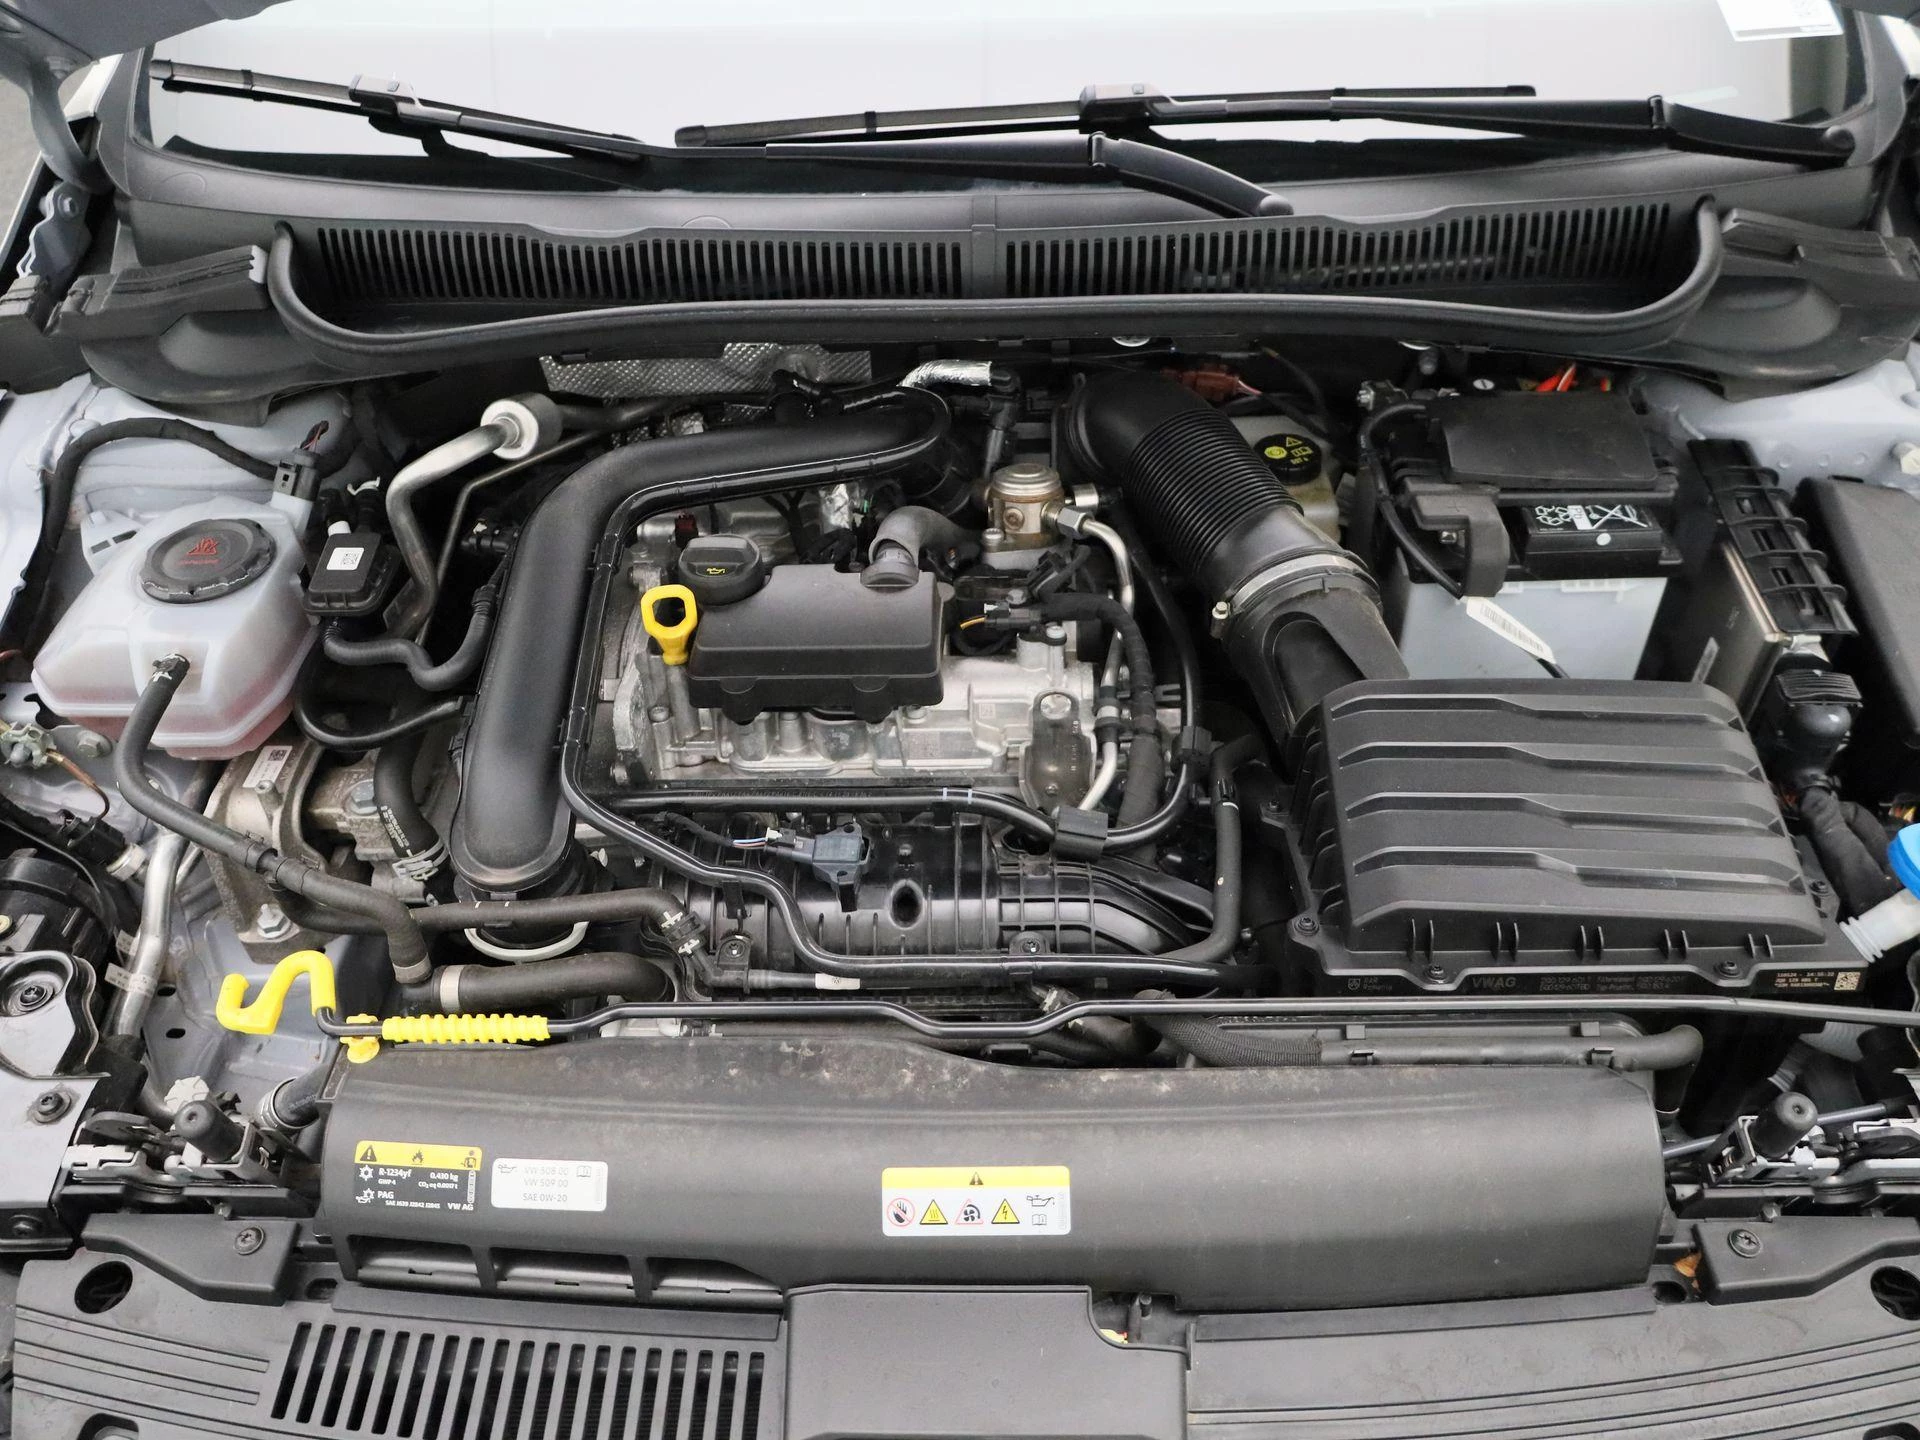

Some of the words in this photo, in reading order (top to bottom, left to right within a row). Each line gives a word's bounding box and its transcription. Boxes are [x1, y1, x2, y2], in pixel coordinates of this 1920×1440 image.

[379, 1167, 412, 1179] R-1234yf
[524, 1167, 537, 1175] VW
[540, 1167, 556, 1175] 508
[450, 1173, 459, 1182] kg
[524, 1179, 537, 1187] VW
[540, 1179, 555, 1187] 509
[558, 1179, 568, 1188] 00
[377, 1190, 394, 1200] PAG
[523, 1193, 537, 1202] SAE
[540, 1193, 568, 1203] 0W-20
[461, 1203, 474, 1211] AG
